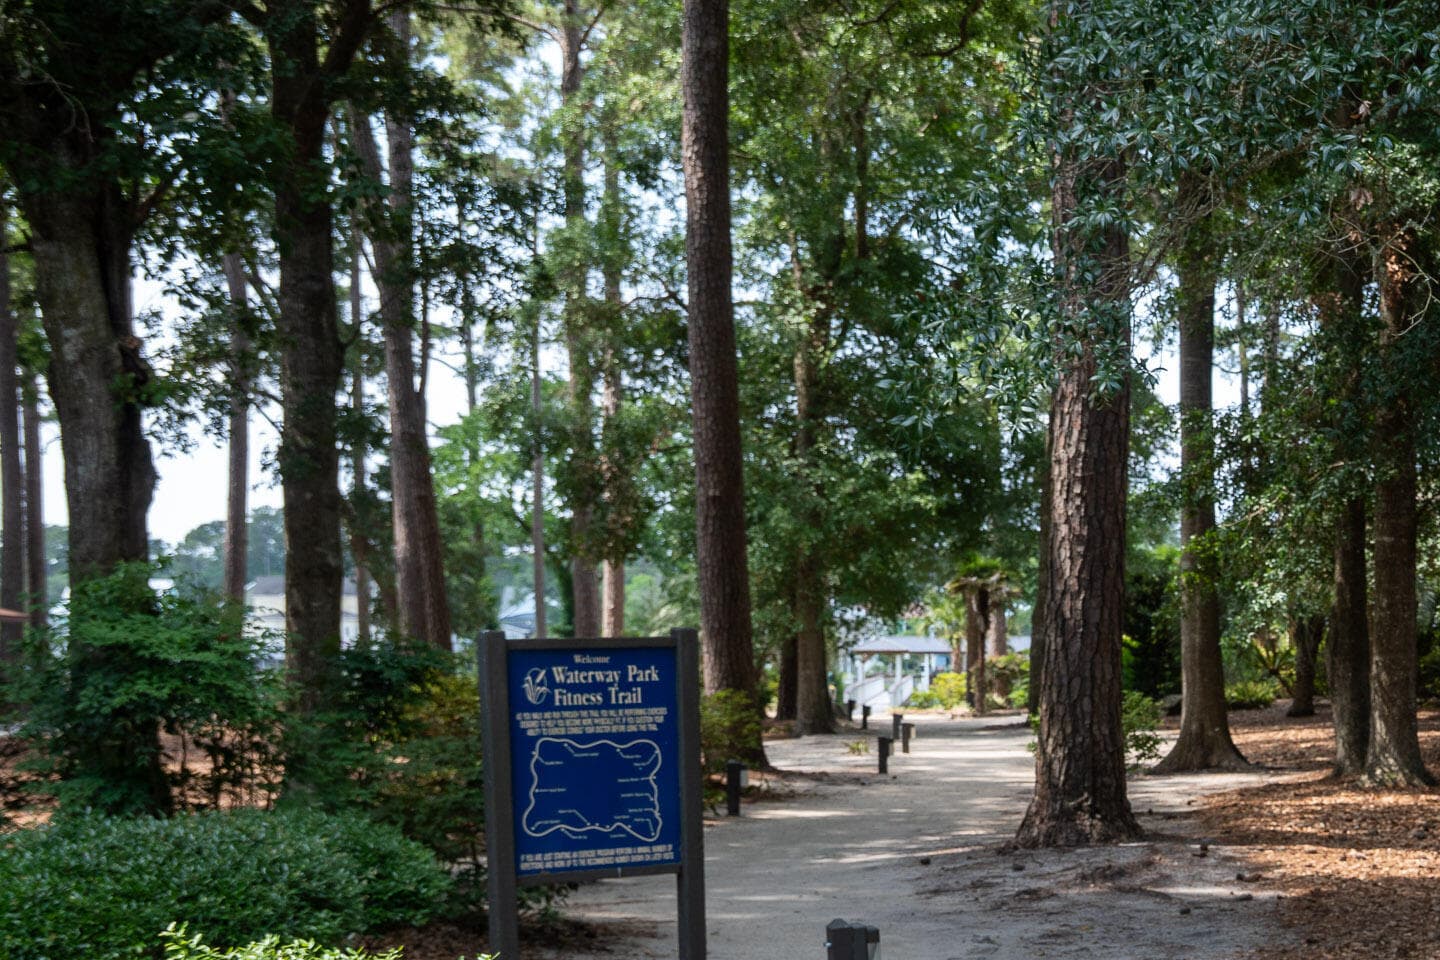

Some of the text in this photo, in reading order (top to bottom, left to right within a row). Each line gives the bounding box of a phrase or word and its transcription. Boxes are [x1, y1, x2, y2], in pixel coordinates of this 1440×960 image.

[573, 654, 610, 664] Welcome
[552, 665, 659, 684] Waterway Park
[554, 687, 642, 706] Fitness Trail
